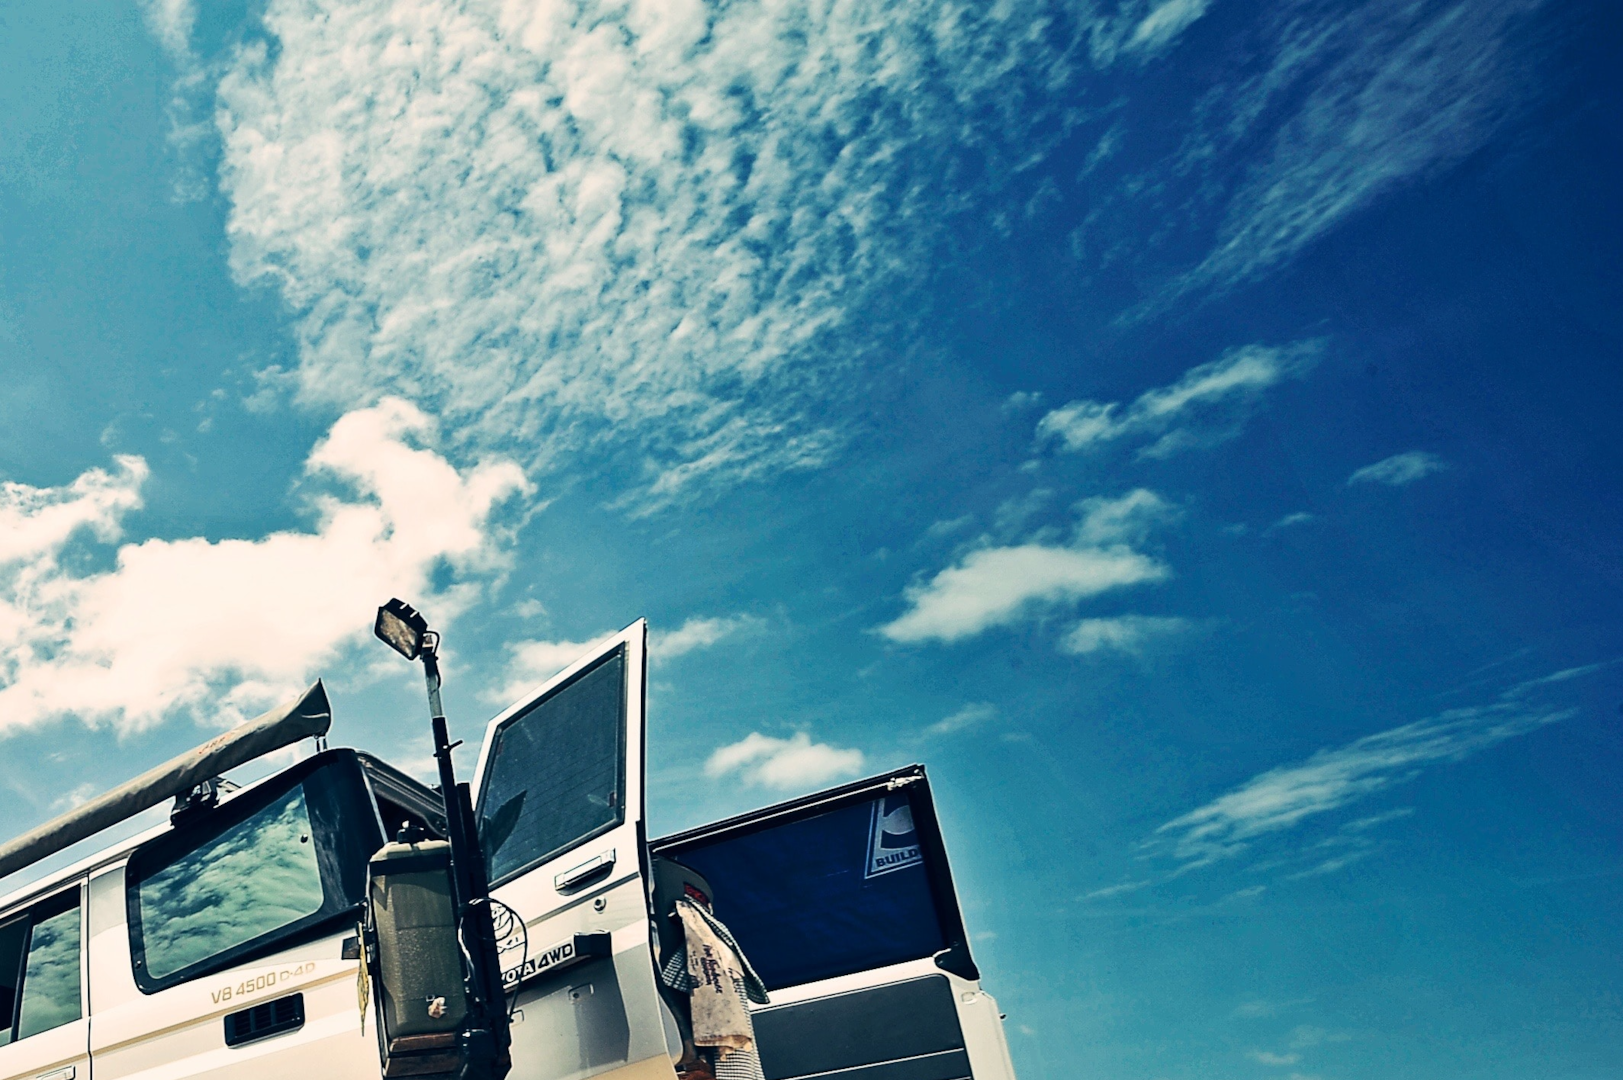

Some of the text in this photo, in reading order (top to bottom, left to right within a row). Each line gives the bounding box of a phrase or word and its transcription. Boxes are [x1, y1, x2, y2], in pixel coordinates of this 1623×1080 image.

[876, 849, 918, 867] BUILD
[537, 943, 573, 969] 4WD
[211, 986, 232, 1004] V8
[235, 972, 276, 995] 4500
